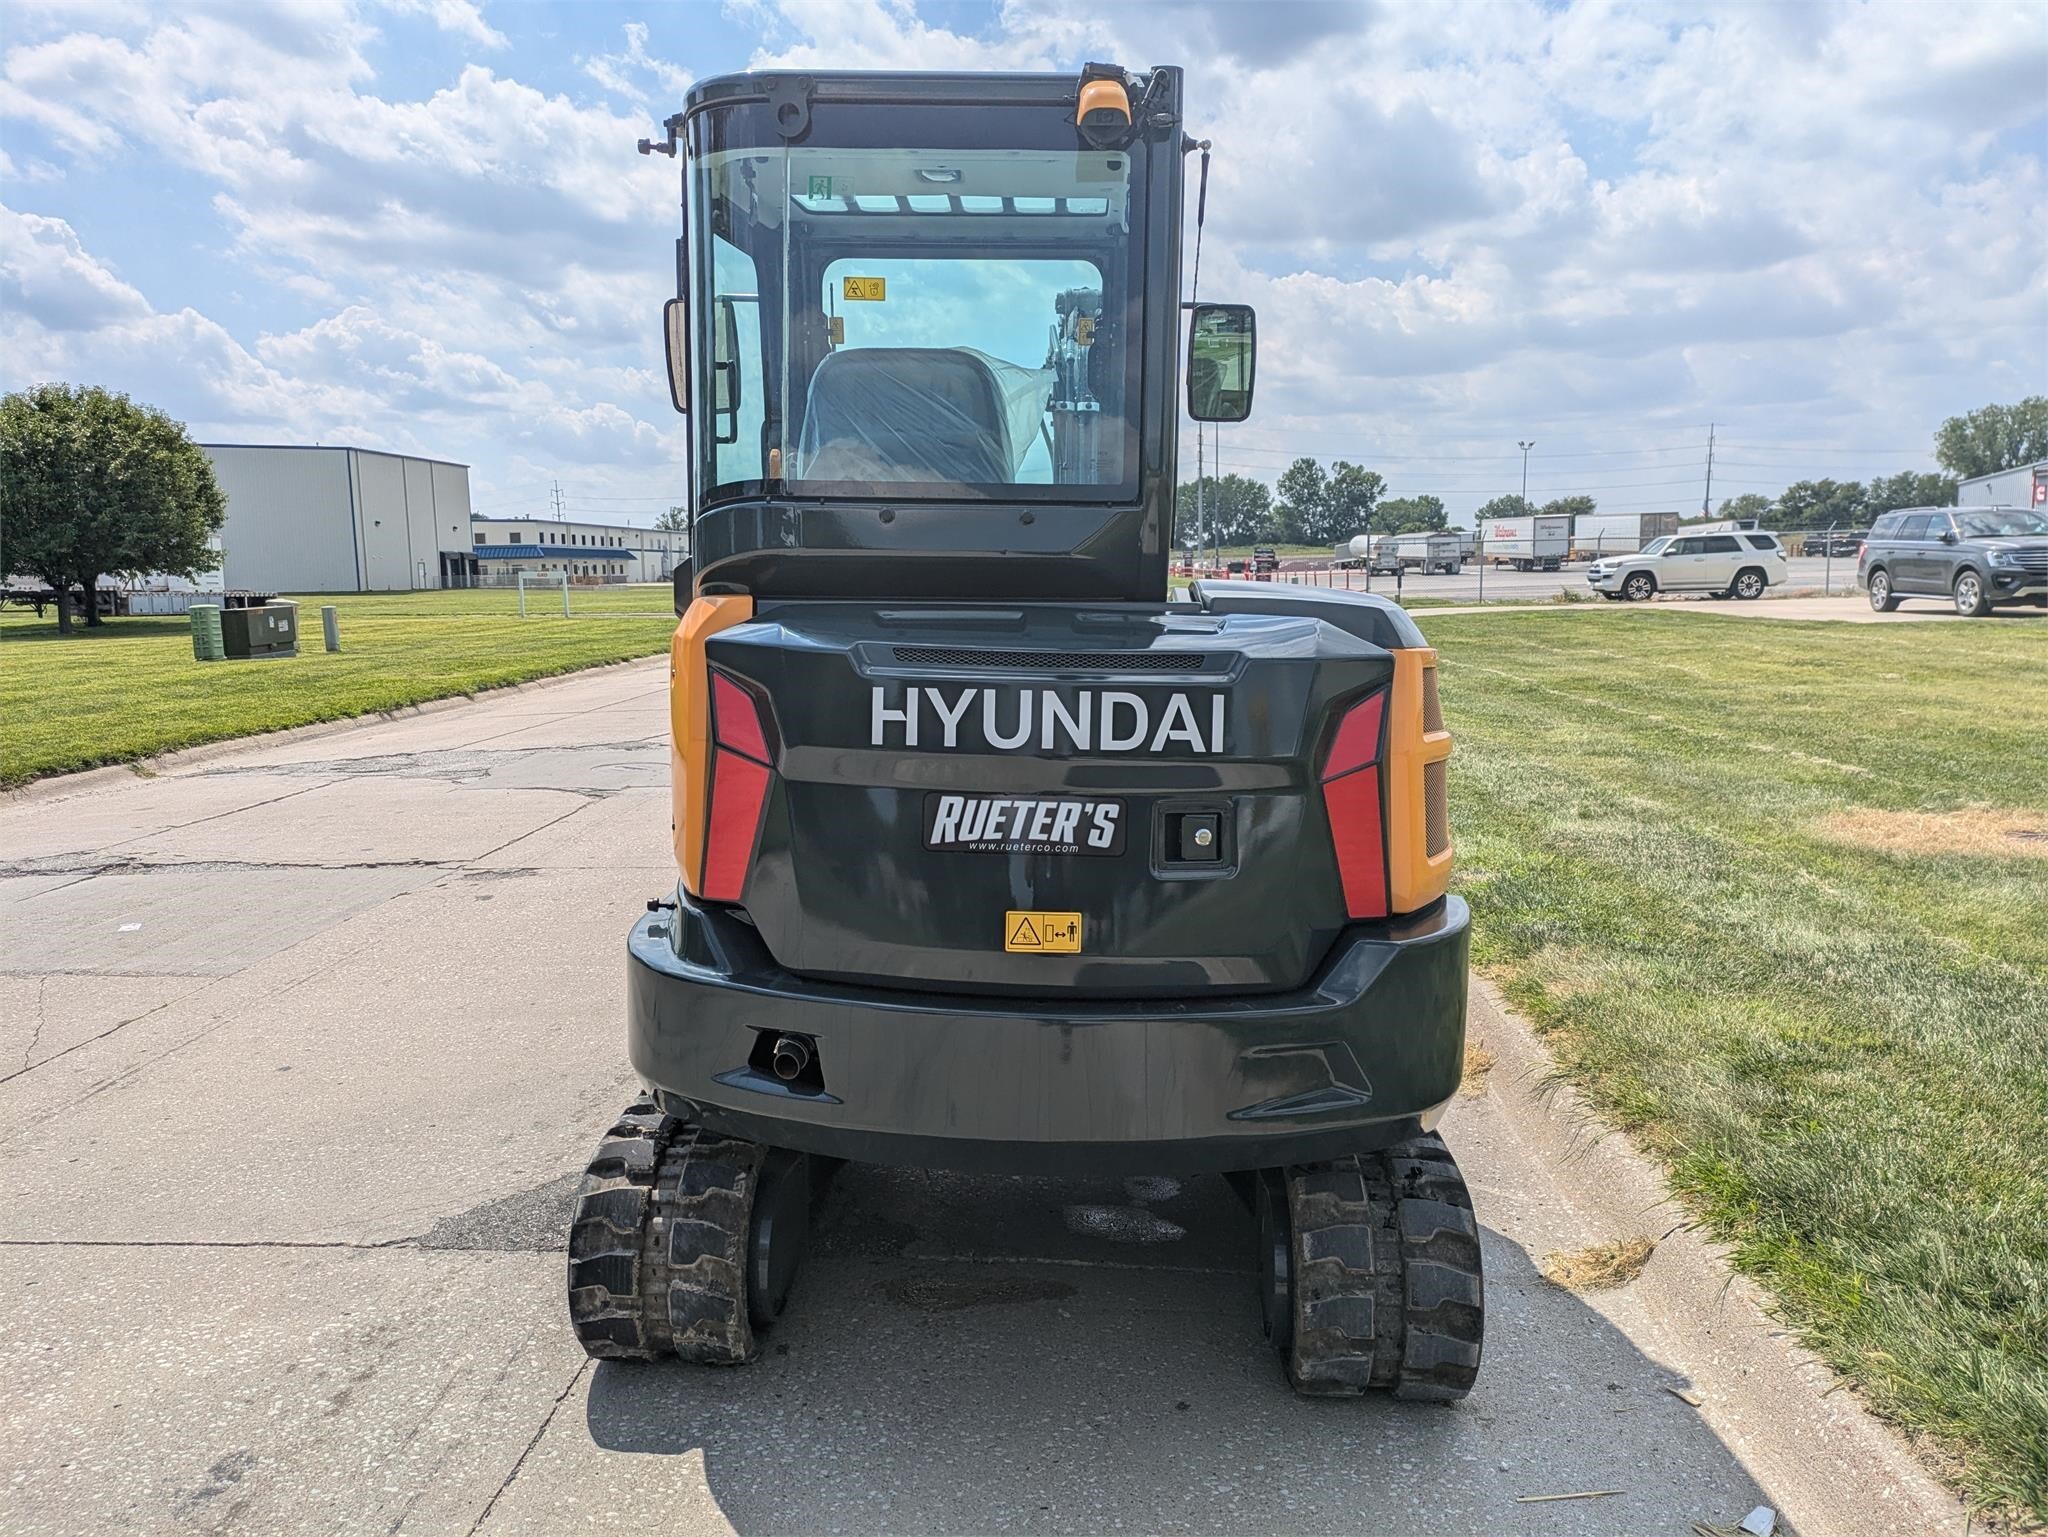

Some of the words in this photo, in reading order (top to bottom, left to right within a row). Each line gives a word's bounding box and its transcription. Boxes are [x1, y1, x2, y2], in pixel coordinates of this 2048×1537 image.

[871, 686, 1225, 753] HYUNDAI
[930, 795, 1120, 849] RUETER'S
[968, 841, 1079, 853] www.rueterco.com
